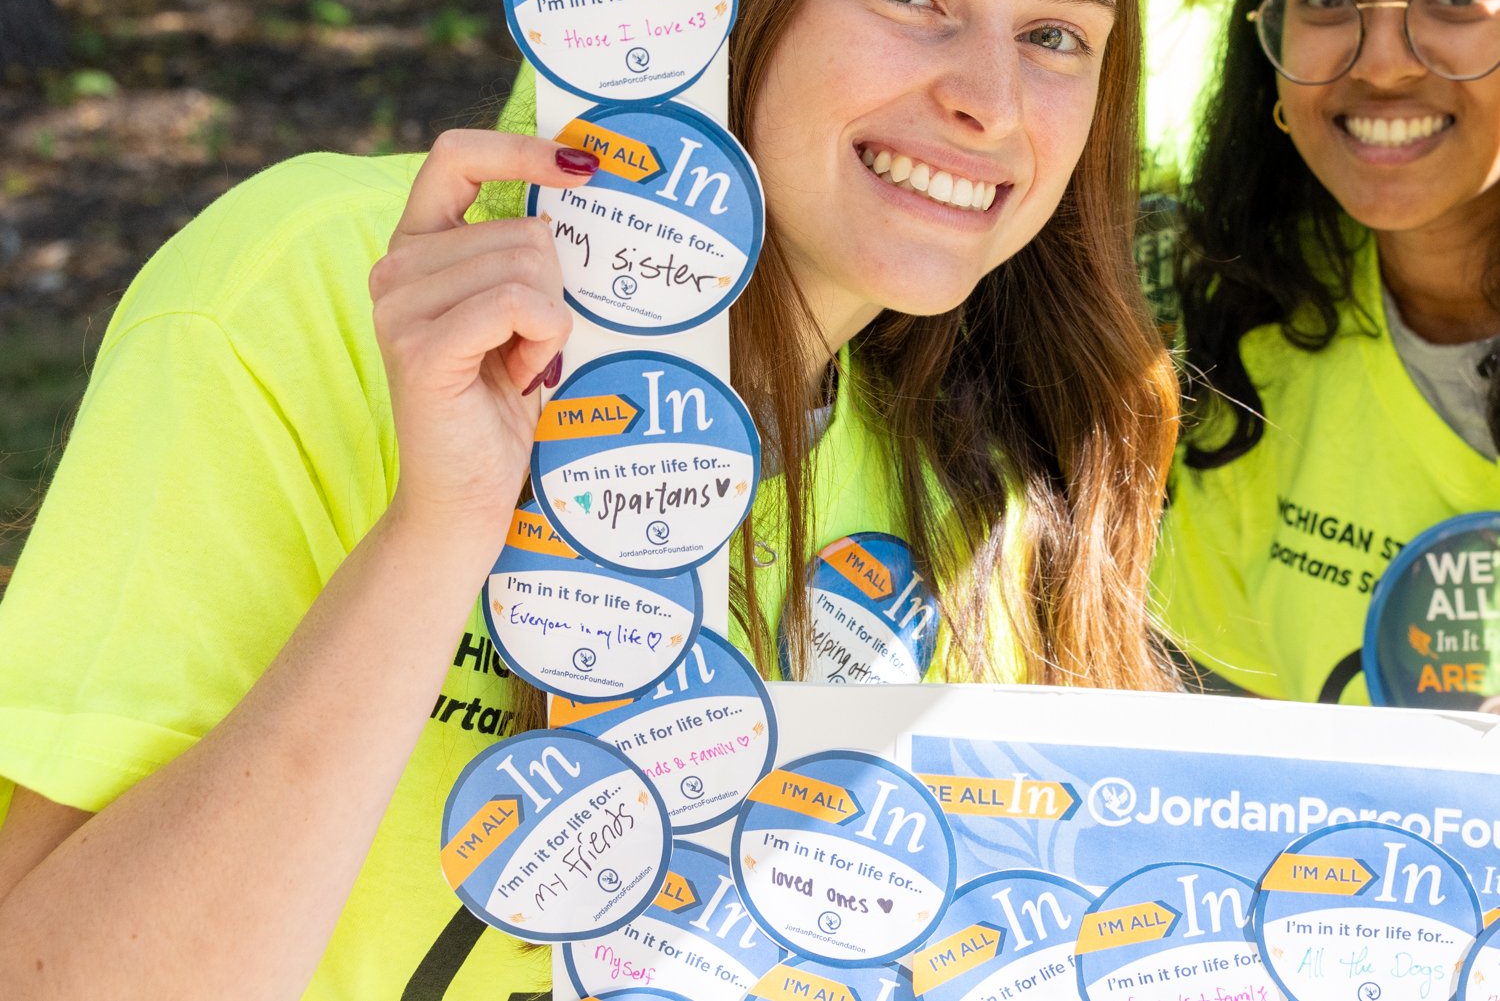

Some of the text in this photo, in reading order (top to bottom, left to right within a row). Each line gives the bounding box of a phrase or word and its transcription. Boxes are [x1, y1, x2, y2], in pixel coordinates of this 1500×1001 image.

[563, 28, 612, 50] those
[618, 23, 636, 43] I
[645, 19, 683, 37] love
[554, 220, 718, 293] my sister
[577, 286, 663, 321] JordanPorcoFoundation
[562, 457, 731, 483] I'm in it for life for...
[618, 544, 704, 559] JordanPorcoFoundation
[845, 552, 935, 642] I'M ALL In
[617, 625, 642, 645] life
[1437, 629, 1459, 653] In
[1462, 628, 1480, 651] It
[1417, 663, 1488, 694] ARE
[689, 739, 737, 766] family
[456, 745, 581, 859] I'M ALL In
[959, 786, 1005, 806] ALL
[1006, 772, 1059, 816] In
[763, 833, 924, 894] I'm in it for life for...
[1292, 841, 1447, 907] I'M ALL In
[771, 867, 869, 914] loved ones
